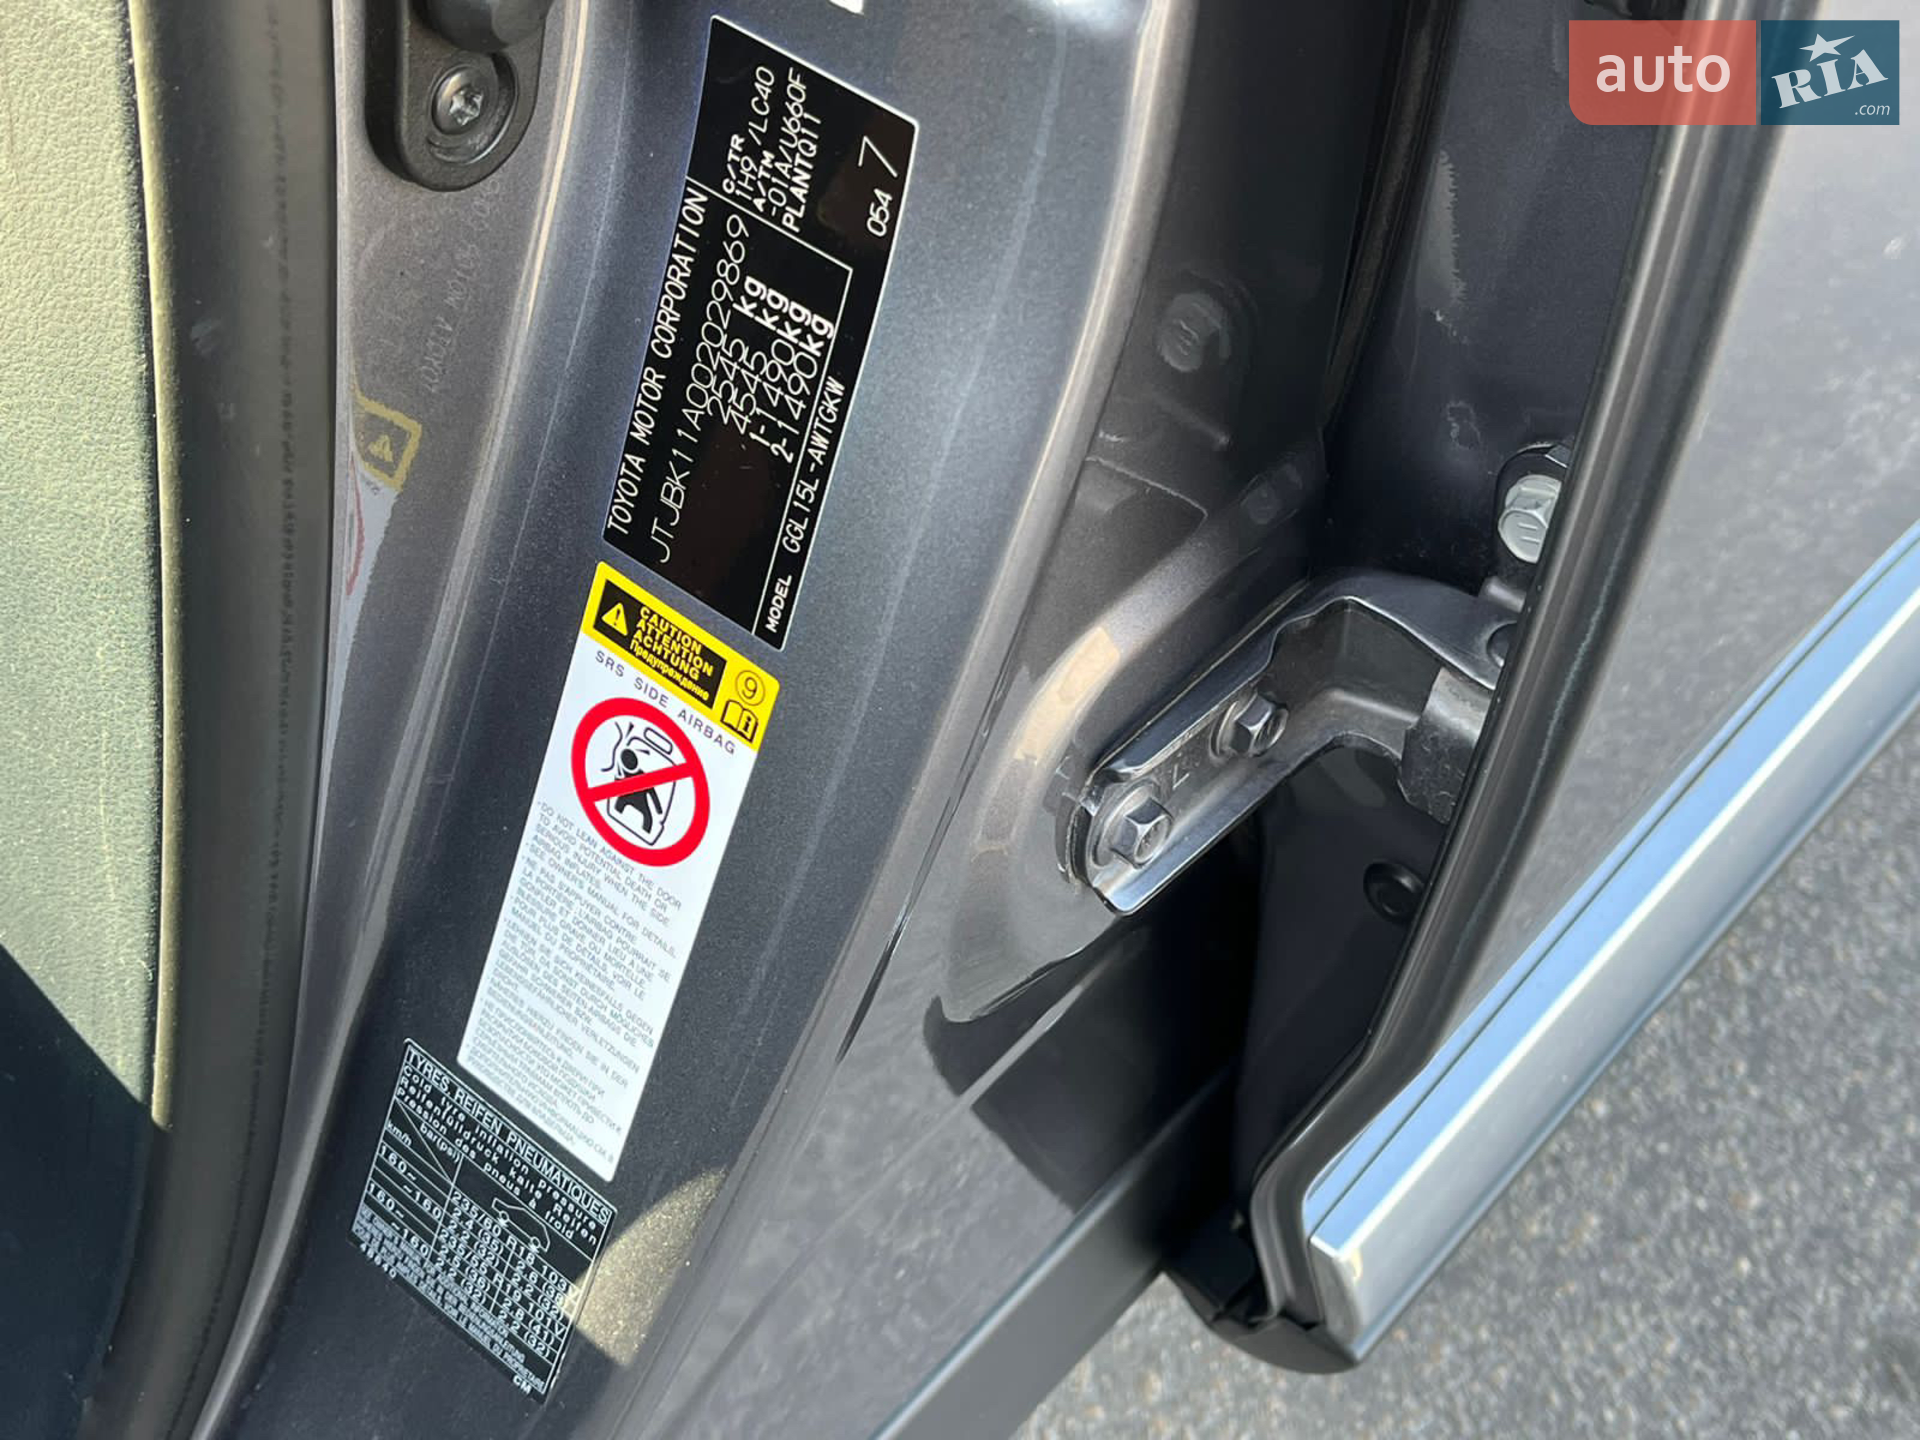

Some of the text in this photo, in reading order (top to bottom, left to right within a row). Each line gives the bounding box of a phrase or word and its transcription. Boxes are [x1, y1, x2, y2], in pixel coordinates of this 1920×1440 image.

[722, 134, 744, 194] C/TR
[753, 150, 775, 212] A/TM
[858, 136, 897, 236] 054 7
[607, 187, 708, 534] TOYOTA MOTOR CORPORATION
[651, 214, 749, 563] JTJBK11A002029869
[706, 273, 767, 424] 2545 kg
[725, 283, 789, 434] 4545 kg
[765, 376, 845, 632] MODEL GGL15L-AWTGKW
[632, 627, 700, 681] ACHTUNG
[635, 616, 714, 677] ATTENTION
[638, 604, 702, 655] CAUTION
[594, 649, 736, 755] SRS SIDE AIRBAG
[740, 673, 759, 702] 9
[556, 813, 574, 832] NOT
[637, 872, 654, 891] THE
[386, 1119, 413, 1148] km/h
[402, 1064, 432, 1095] Cold
[439, 1095, 466, 1124] tyre
[474, 1124, 529, 1175] inflation
[538, 1177, 597, 1231] pressure
[419, 1122, 461, 1164] bar(psi)
[453, 1086, 502, 1136] REIFEN
[505, 1129, 609, 1224] PNEUMATIQUES
[451, 1189, 502, 1238] 235/60
[454, 1134, 477, 1159] des
[483, 1159, 521, 1197] pneus
[544, 1209, 574, 1240] froid
[508, 1166, 543, 1200] kalte
[552, 1202, 597, 1246] Reifen
[439, 1227, 489, 1276] 235/55
[472, 1239, 500, 1269] (32)
[536, 1292, 564, 1322] (32)
[476, 1226, 504, 1257] (35)
[459, 1276, 487, 1307] (32)
[523, 1329, 550, 1359] (32)
[463, 1264, 491, 1294] (36)
[527, 1317, 555, 1347] (41)
